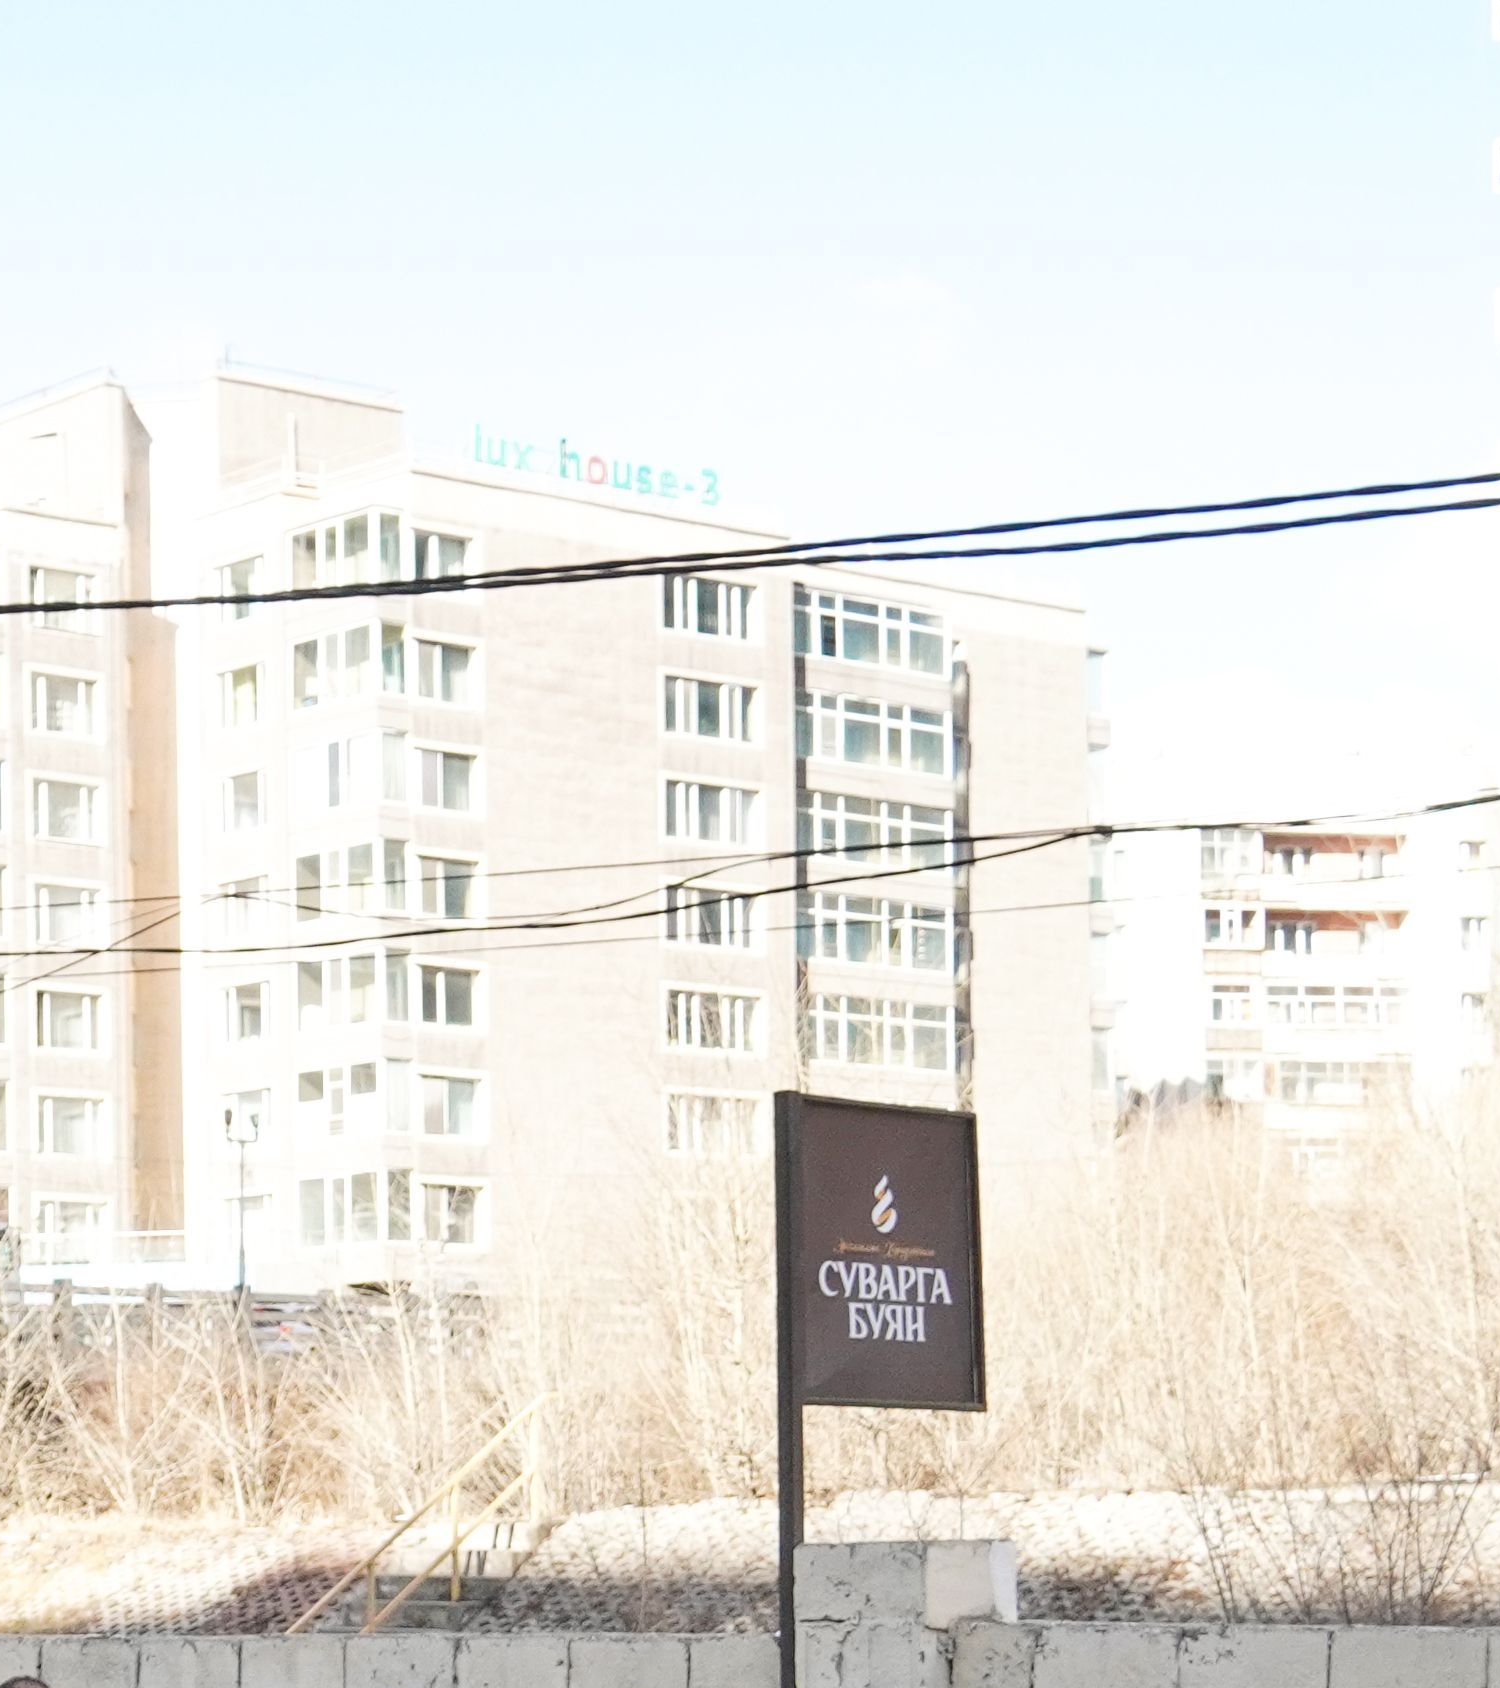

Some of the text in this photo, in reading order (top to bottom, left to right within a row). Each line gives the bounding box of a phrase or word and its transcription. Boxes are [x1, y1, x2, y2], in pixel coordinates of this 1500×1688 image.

[474, 423, 721, 506] lux house-3
[818, 1260, 953, 1305] СУВАРГА
[848, 1302, 926, 1342] БУЯН
